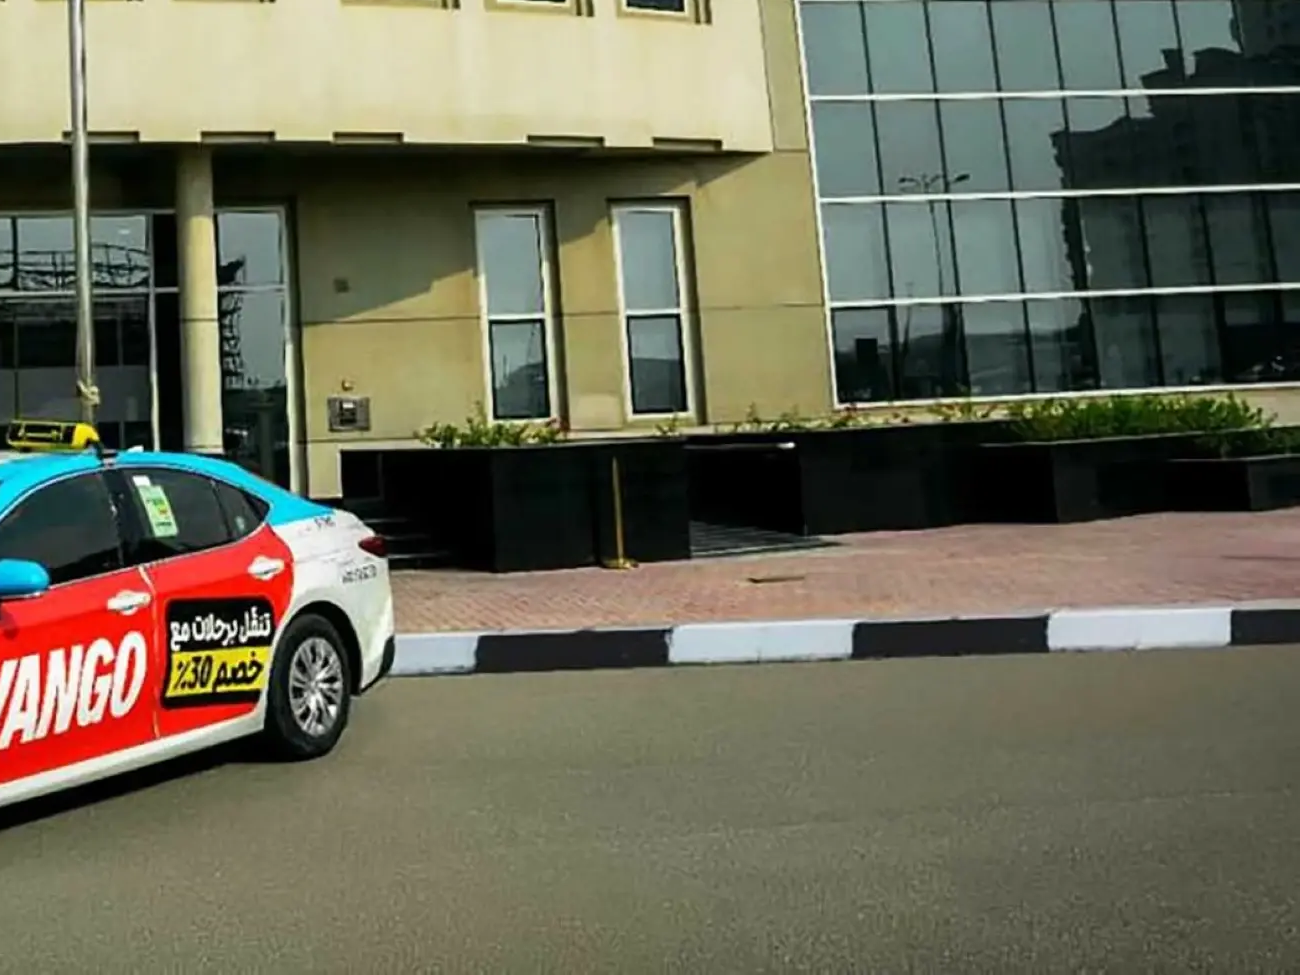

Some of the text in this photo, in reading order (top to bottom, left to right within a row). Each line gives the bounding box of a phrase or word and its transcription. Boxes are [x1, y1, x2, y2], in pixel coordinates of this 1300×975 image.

[170, 621, 191, 651] مع
[191, 612, 238, 646] برحلات
[212, 651, 264, 693] خصم
